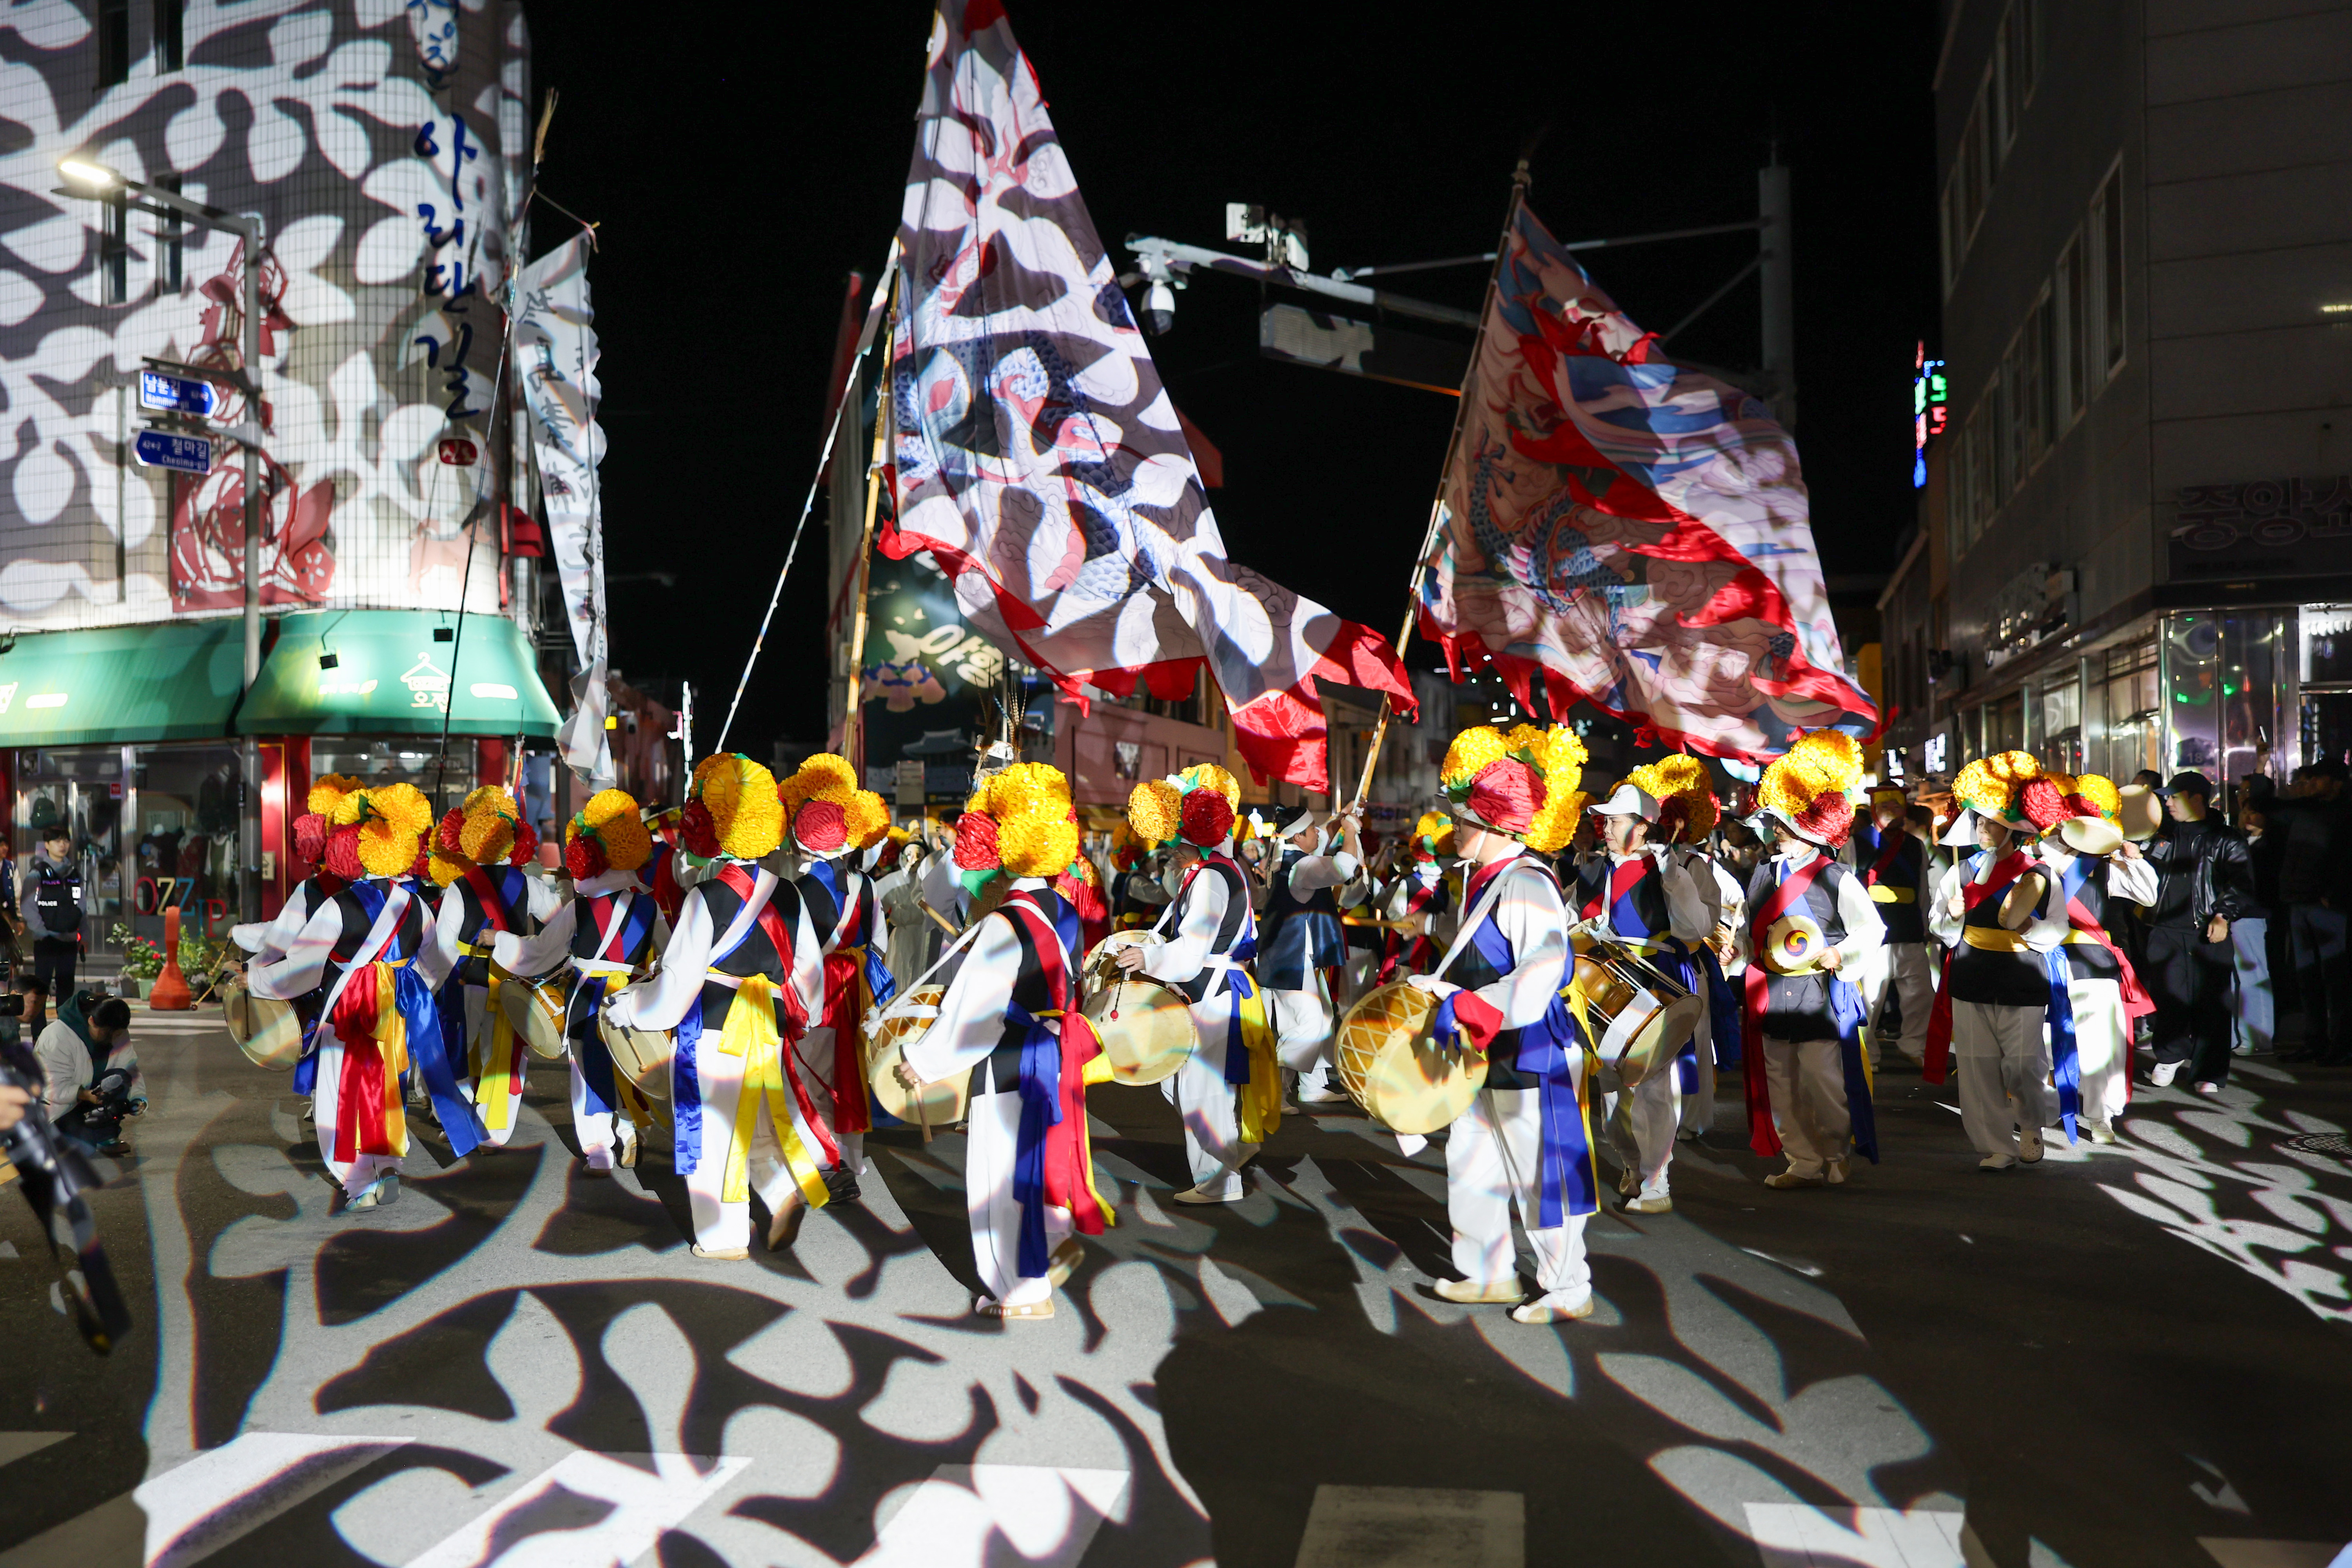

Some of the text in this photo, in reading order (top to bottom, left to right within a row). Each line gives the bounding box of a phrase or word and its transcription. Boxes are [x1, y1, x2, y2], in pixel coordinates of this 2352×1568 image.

[414, 112, 479, 419] 아리단길
[144, 374, 181, 397] 남문길
[146, 393, 189, 410] Nammun-gil
[172, 438, 207, 459] 철마길
[162, 454, 207, 470] Cheolma-gil
[431, 760, 461, 769] OEN
[2187, 752, 2203, 763] 18
[134, 876, 227, 938] OZZIP
